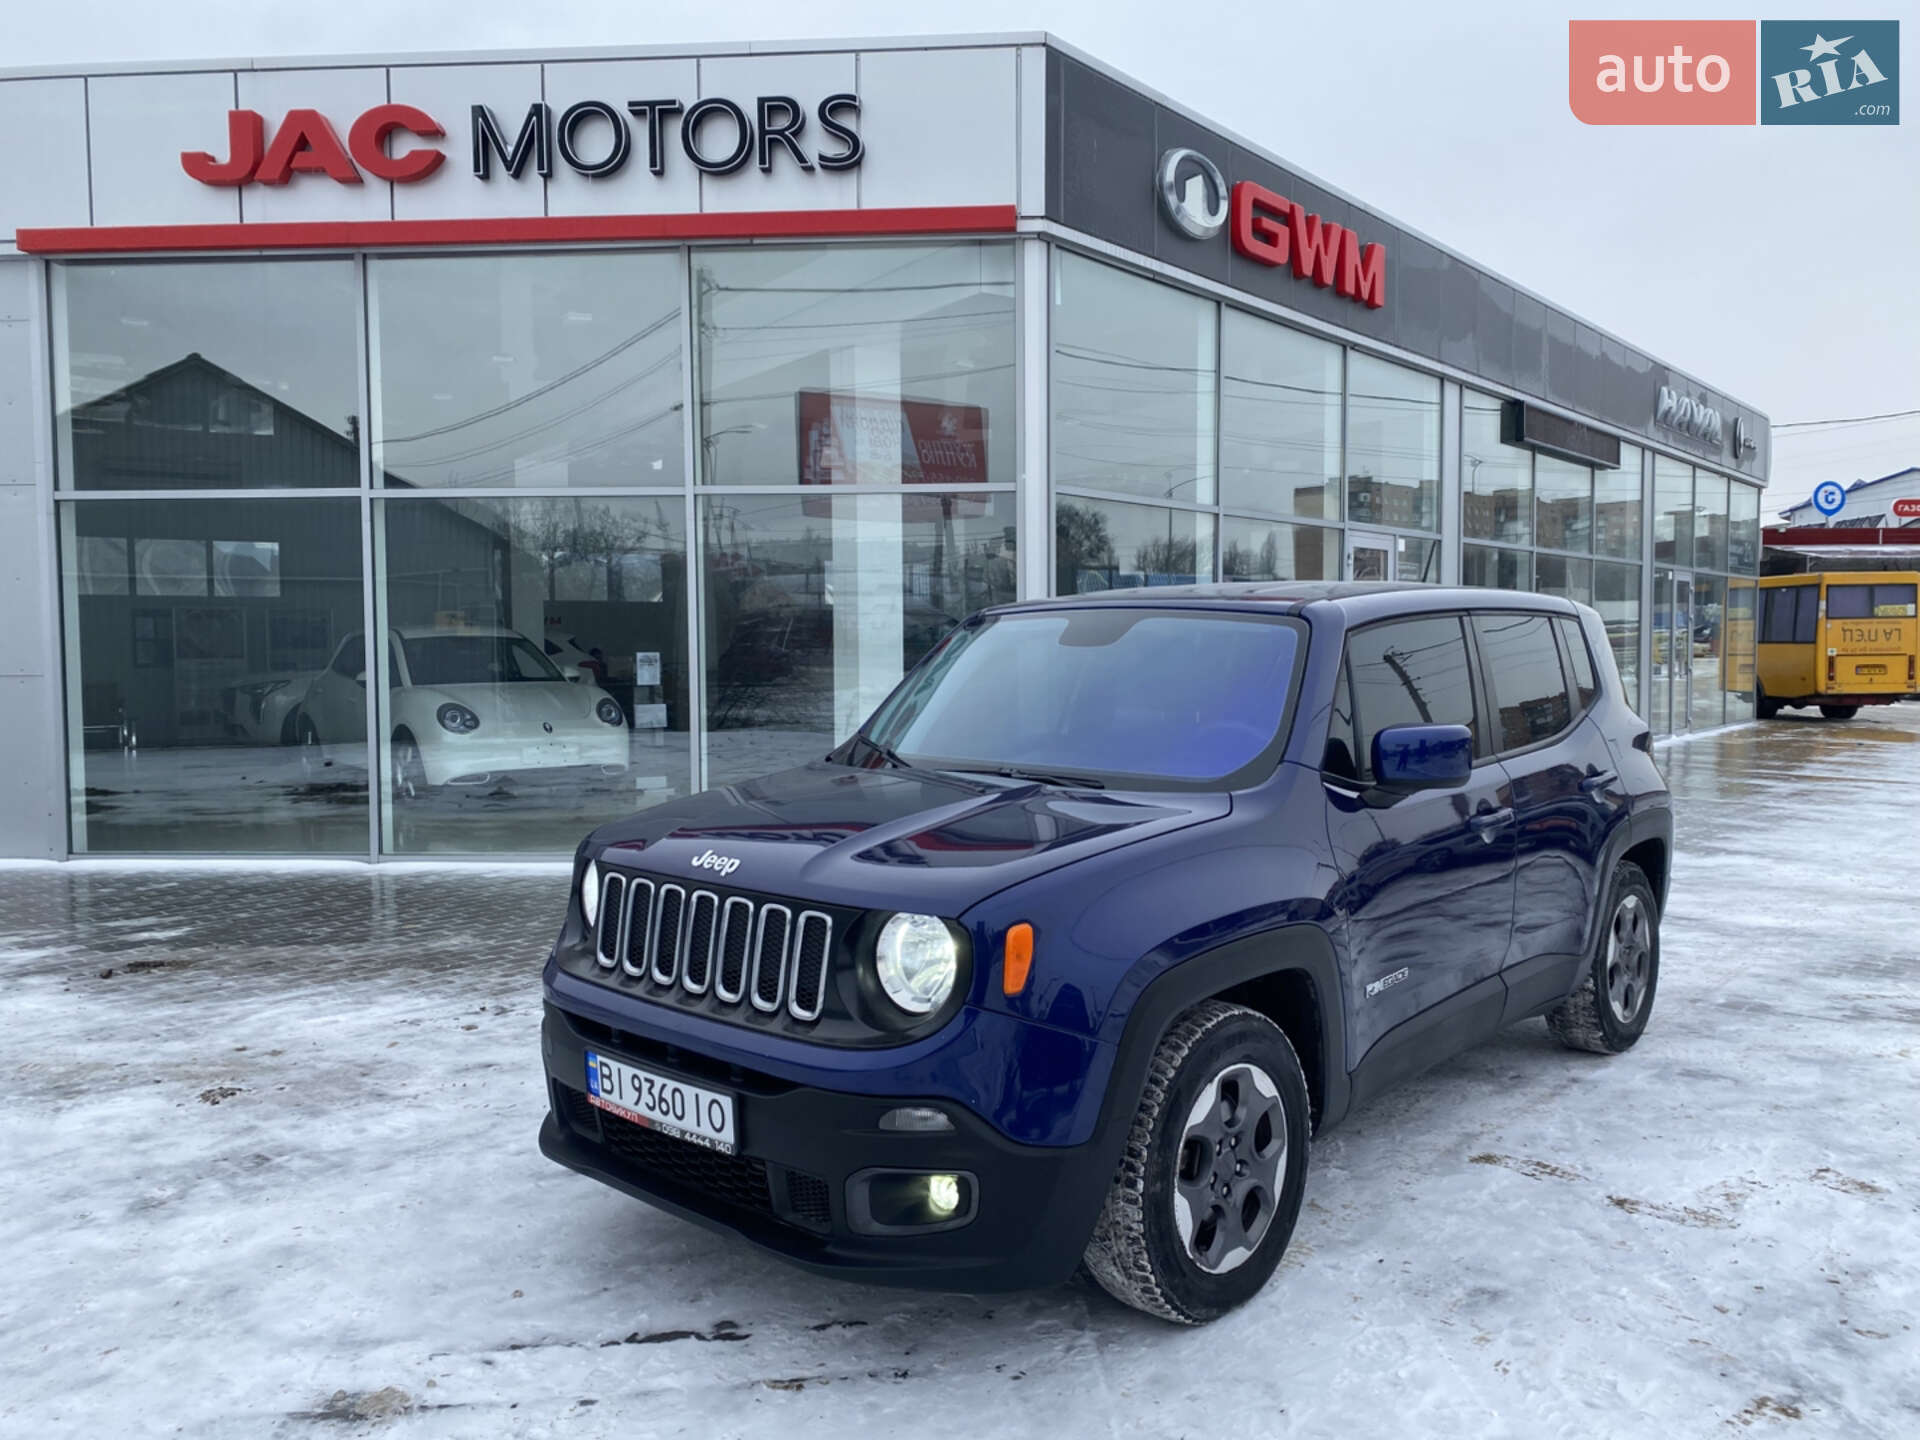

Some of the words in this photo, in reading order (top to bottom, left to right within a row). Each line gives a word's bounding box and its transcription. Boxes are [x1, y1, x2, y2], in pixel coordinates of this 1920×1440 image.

[180, 103, 446, 187] JAC
[470, 94, 864, 181] MOTORS
[1231, 180, 1385, 309] GWM
[691, 849, 741, 877] Jeep
[599, 1061, 623, 1101] BI
[631, 1074, 686, 1121] 9360
